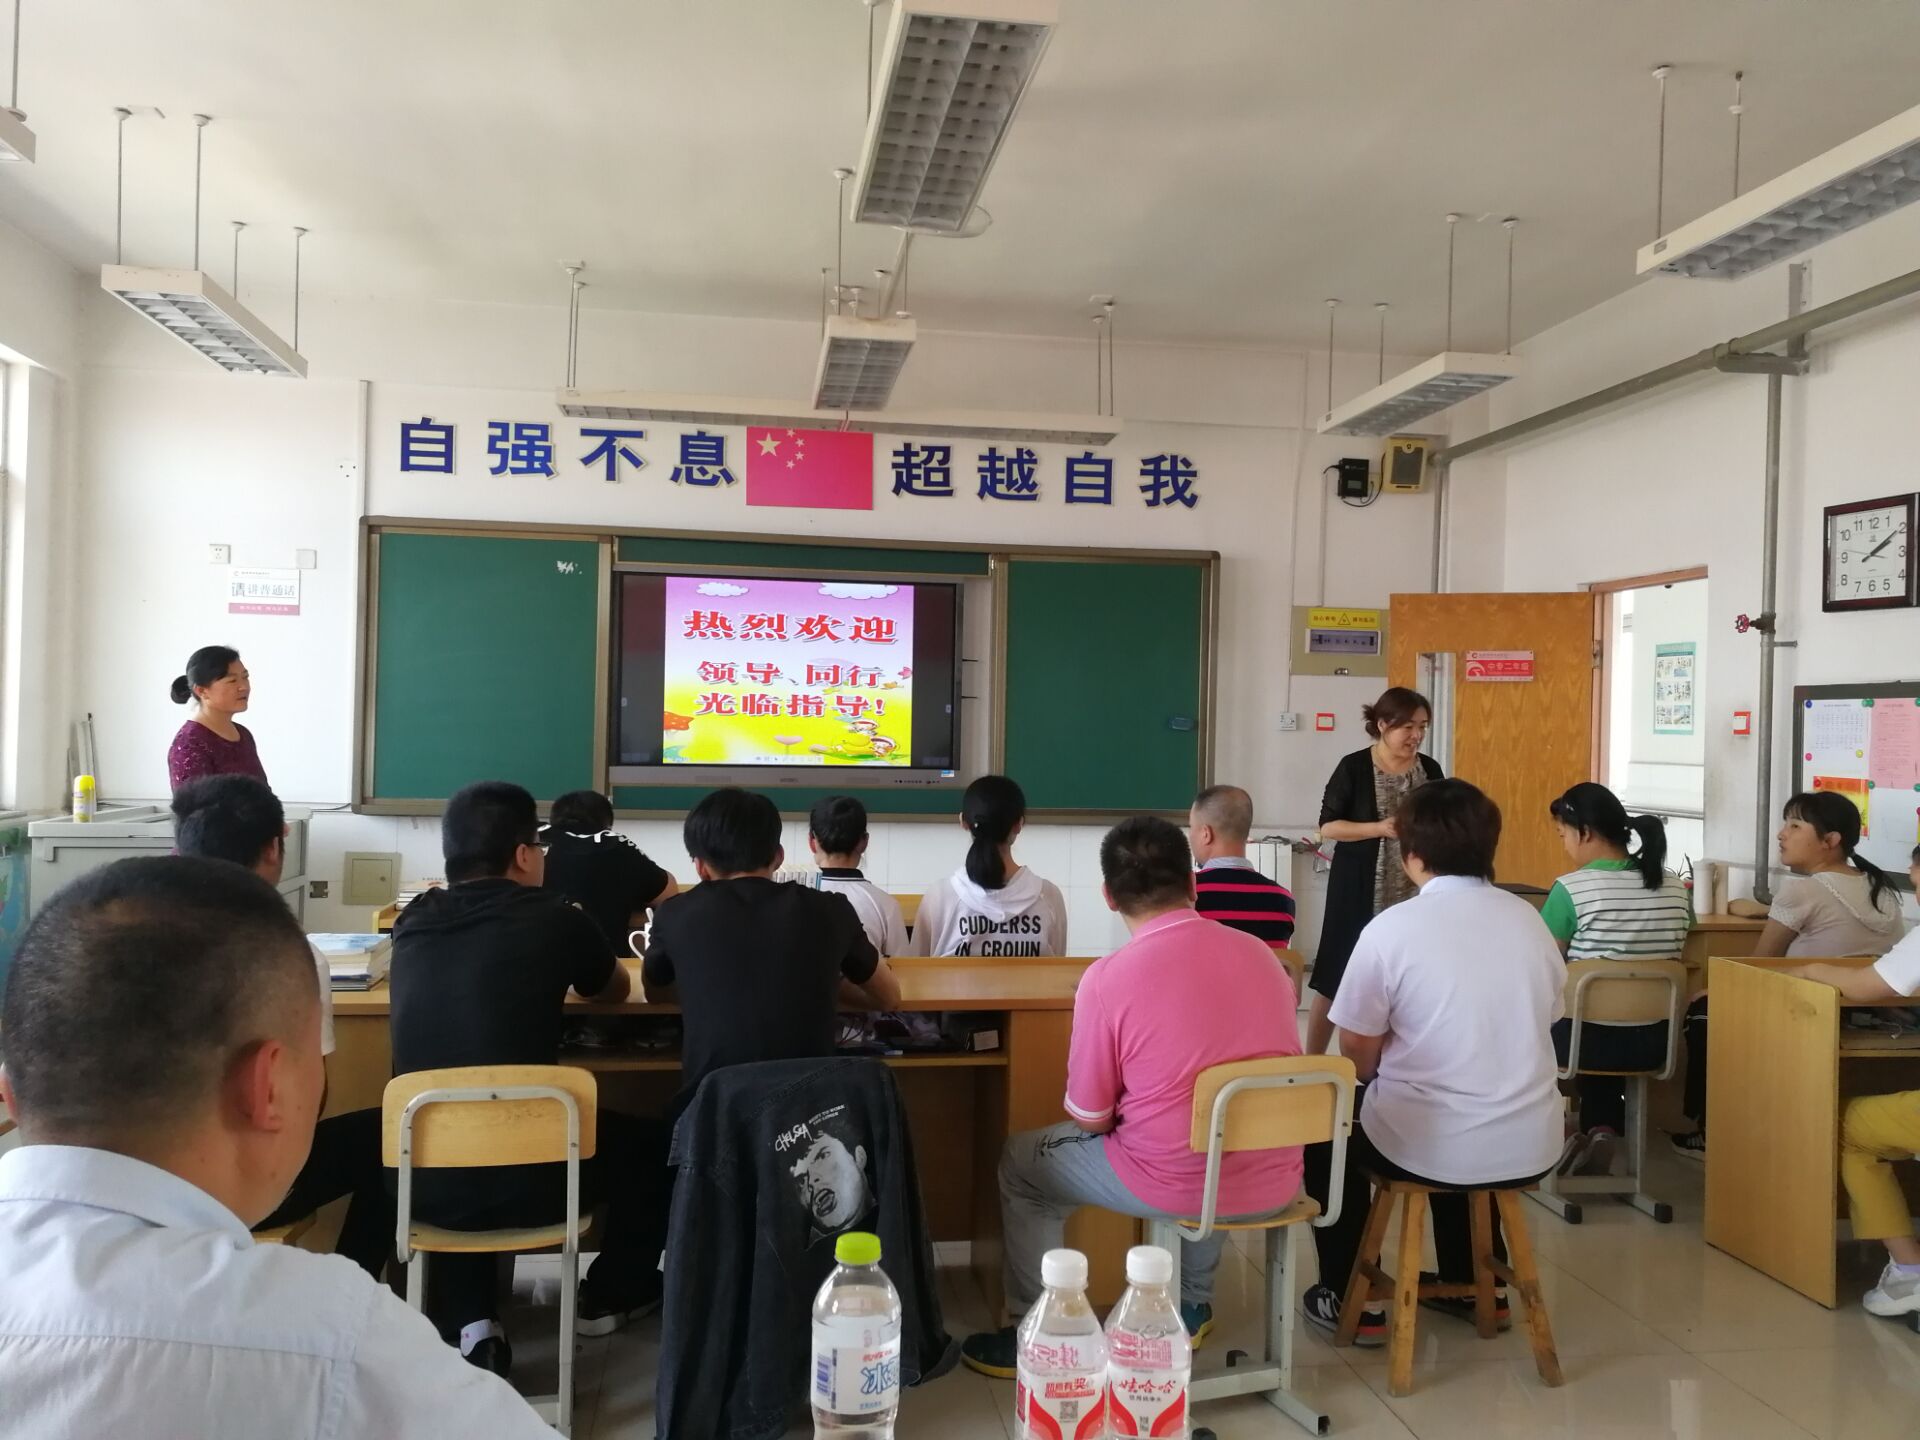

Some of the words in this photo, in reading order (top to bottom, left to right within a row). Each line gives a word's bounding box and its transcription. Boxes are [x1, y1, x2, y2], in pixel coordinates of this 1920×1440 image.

[400, 417, 737, 487] 自强不息
[891, 442, 1201, 509] 超越自我
[1854, 520, 1863, 531] 11
[1869, 517, 1880, 529] 12
[1885, 516, 1890, 527] 1
[1899, 522, 1906, 534] 2
[1840, 529, 1850, 541] 10
[1898, 545, 1906, 557] 3
[1841, 552, 1848, 563] 9
[1841, 574, 1848, 586] 8
[1898, 569, 1906, 580] 4
[1854, 581, 1861, 592] 7
[1868, 580, 1876, 592] 6
[1883, 579, 1890, 590] 5
[683, 610, 899, 644] 热烈欢迎
[697, 660, 884, 688] 领导、同行
[959, 915, 1041, 936] CUDDERSS
[1317, 1297, 1334, 1320] N
[1118, 1377, 1174, 1393] 娃哈哈
